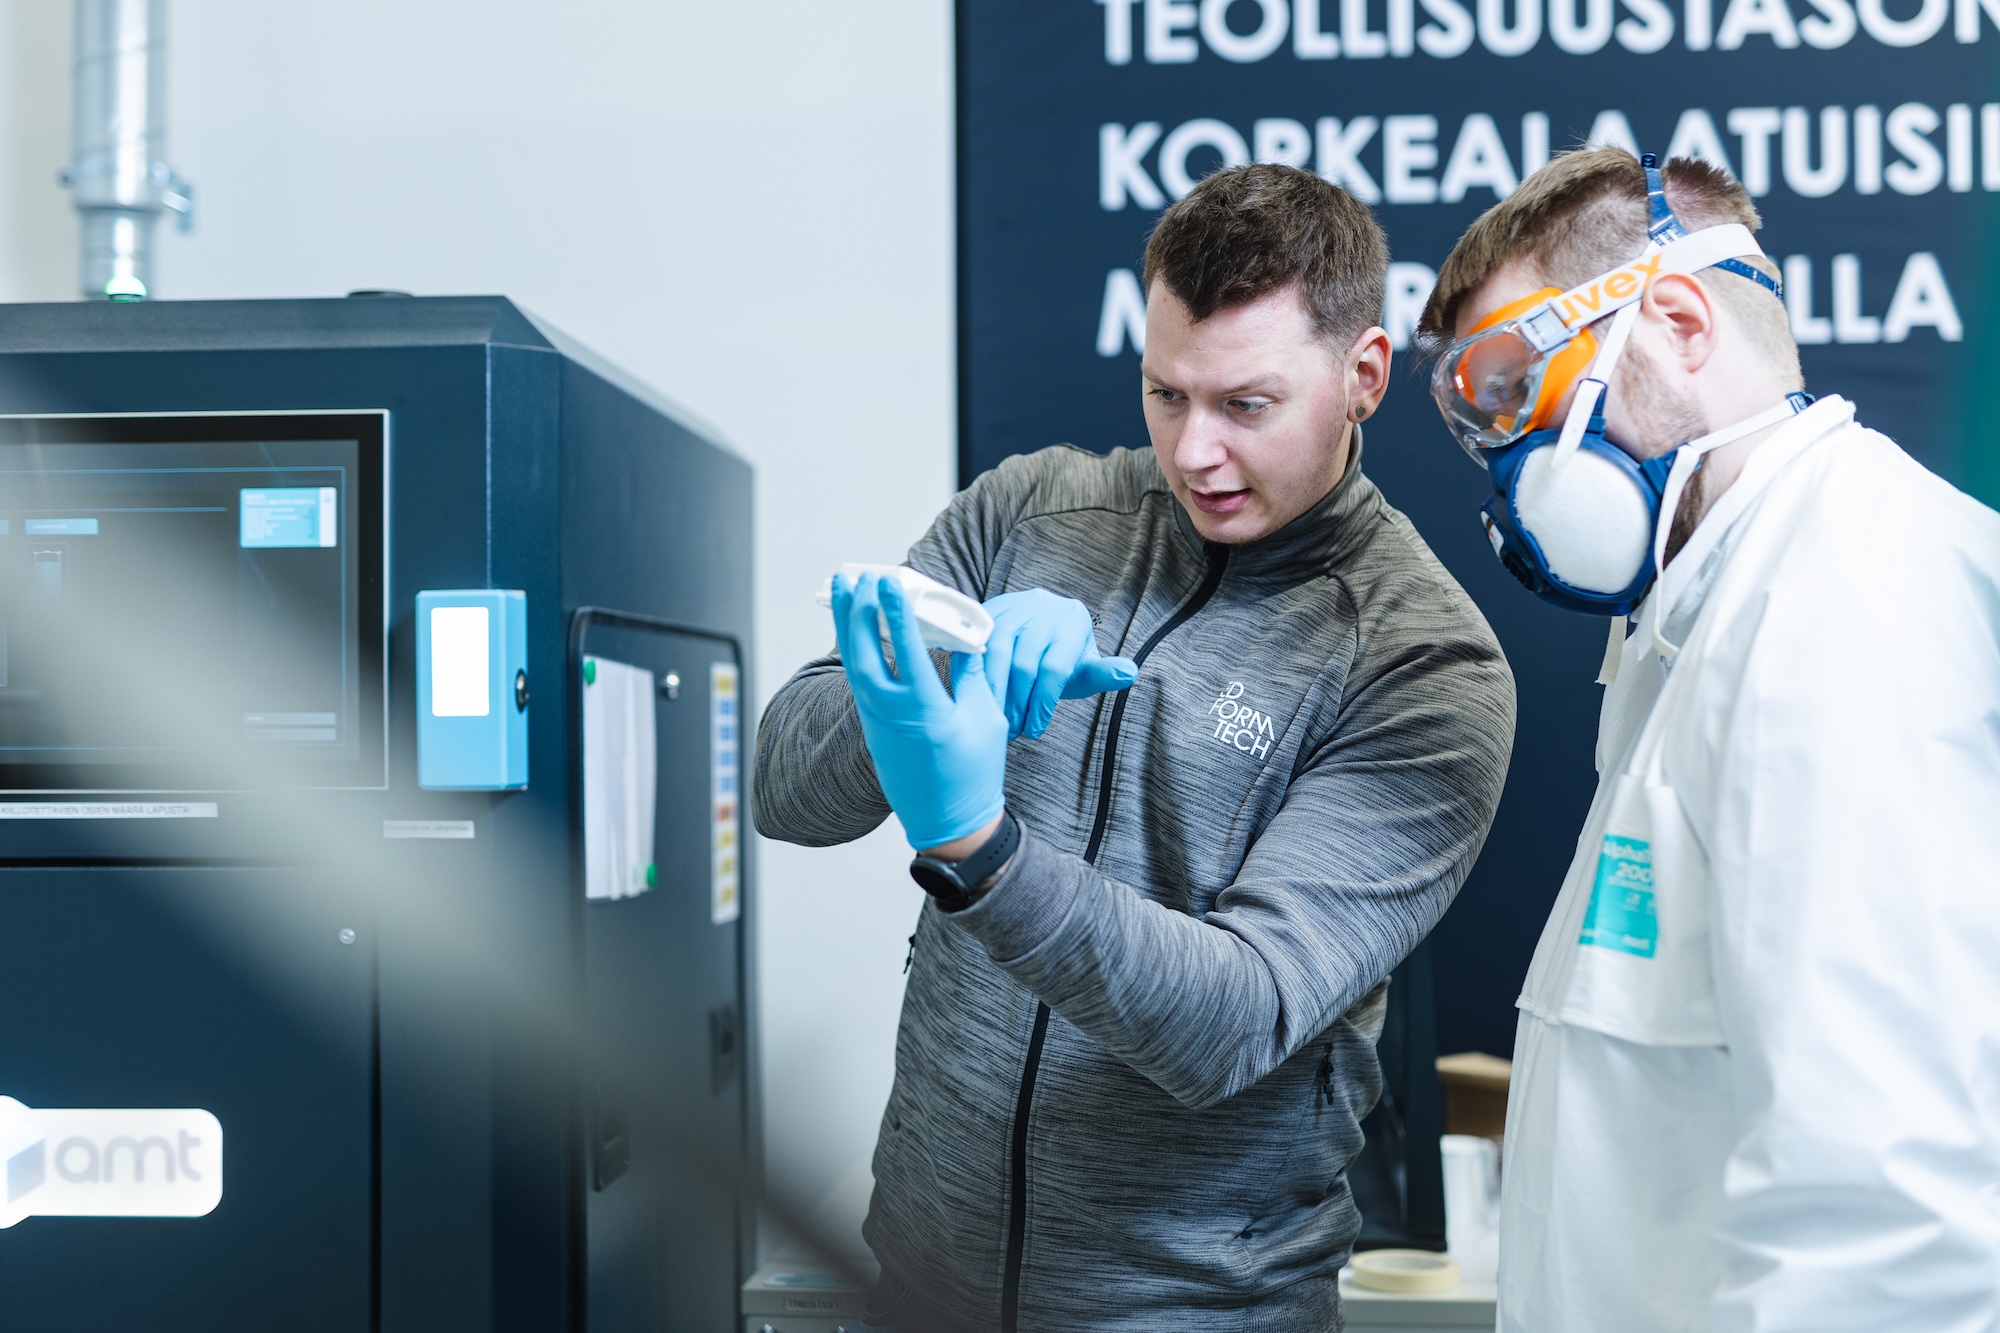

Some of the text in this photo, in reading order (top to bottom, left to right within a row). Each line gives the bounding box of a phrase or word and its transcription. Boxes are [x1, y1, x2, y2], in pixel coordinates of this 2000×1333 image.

[1208, 698, 1275, 741] FORM
[1213, 719, 1271, 760] TECH
[54, 1128, 202, 1184] amt
